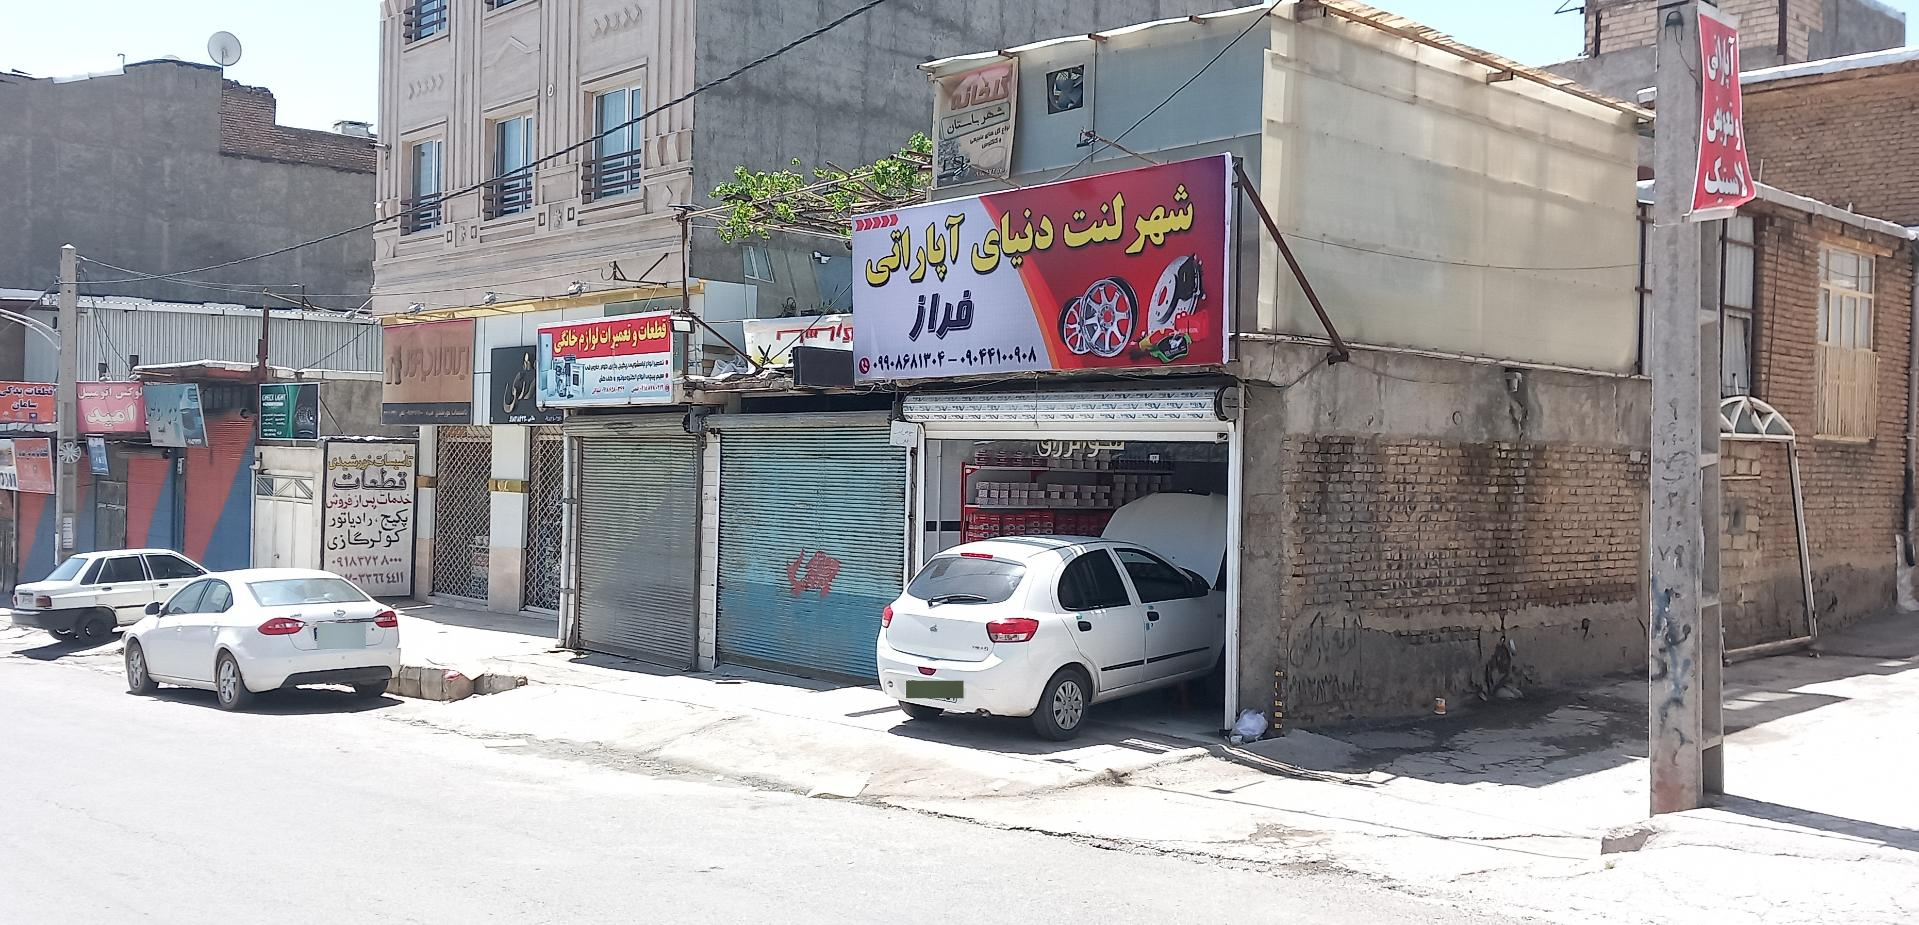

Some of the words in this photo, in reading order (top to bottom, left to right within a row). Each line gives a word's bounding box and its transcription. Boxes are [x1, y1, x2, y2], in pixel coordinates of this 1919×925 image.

[1707, 34, 1735, 88] آپاراتی
[946, 112, 980, 135] باستان
[981, 106, 1005, 125] شهر
[1706, 96, 1734, 147] تعویض
[1735, 118, 1742, 151] و
[1704, 157, 1748, 205] لاستیک
[1063, 191, 1125, 249] لنت
[1124, 184, 1194, 255] شهر
[865, 212, 966, 288] آپاراتی
[970, 207, 1055, 275] دنیای
[908, 289, 975, 342] فراز
[553, 328, 579, 354] خانگی
[578, 326, 600, 352] لوازم
[600, 323, 632, 349] تعمیرات
[631, 329, 638, 347] و
[638, 318, 668, 341] قطعات
[872, 350, 946, 372] ۰۹۹۰۸۶۸۱۳۰۴
[959, 345, 1038, 368] ۰۹۰۴۴۱۰۰۹۰۸
[0, 385, 24, 398] یدکی
[25, 385, 57, 397] قطعات
[11, 399, 38, 410] سامان
[85, 402, 137, 427] امید
[331, 469, 408, 491] قطعات
[325, 493, 353, 509] فروش
[353, 494, 363, 508] از
[362, 496, 377, 510] پس
[376, 492, 412, 506] خدمات
[328, 511, 373, 529] رادیاتور
[326, 529, 369, 550] گازی
[367, 528, 408, 549] کولر
